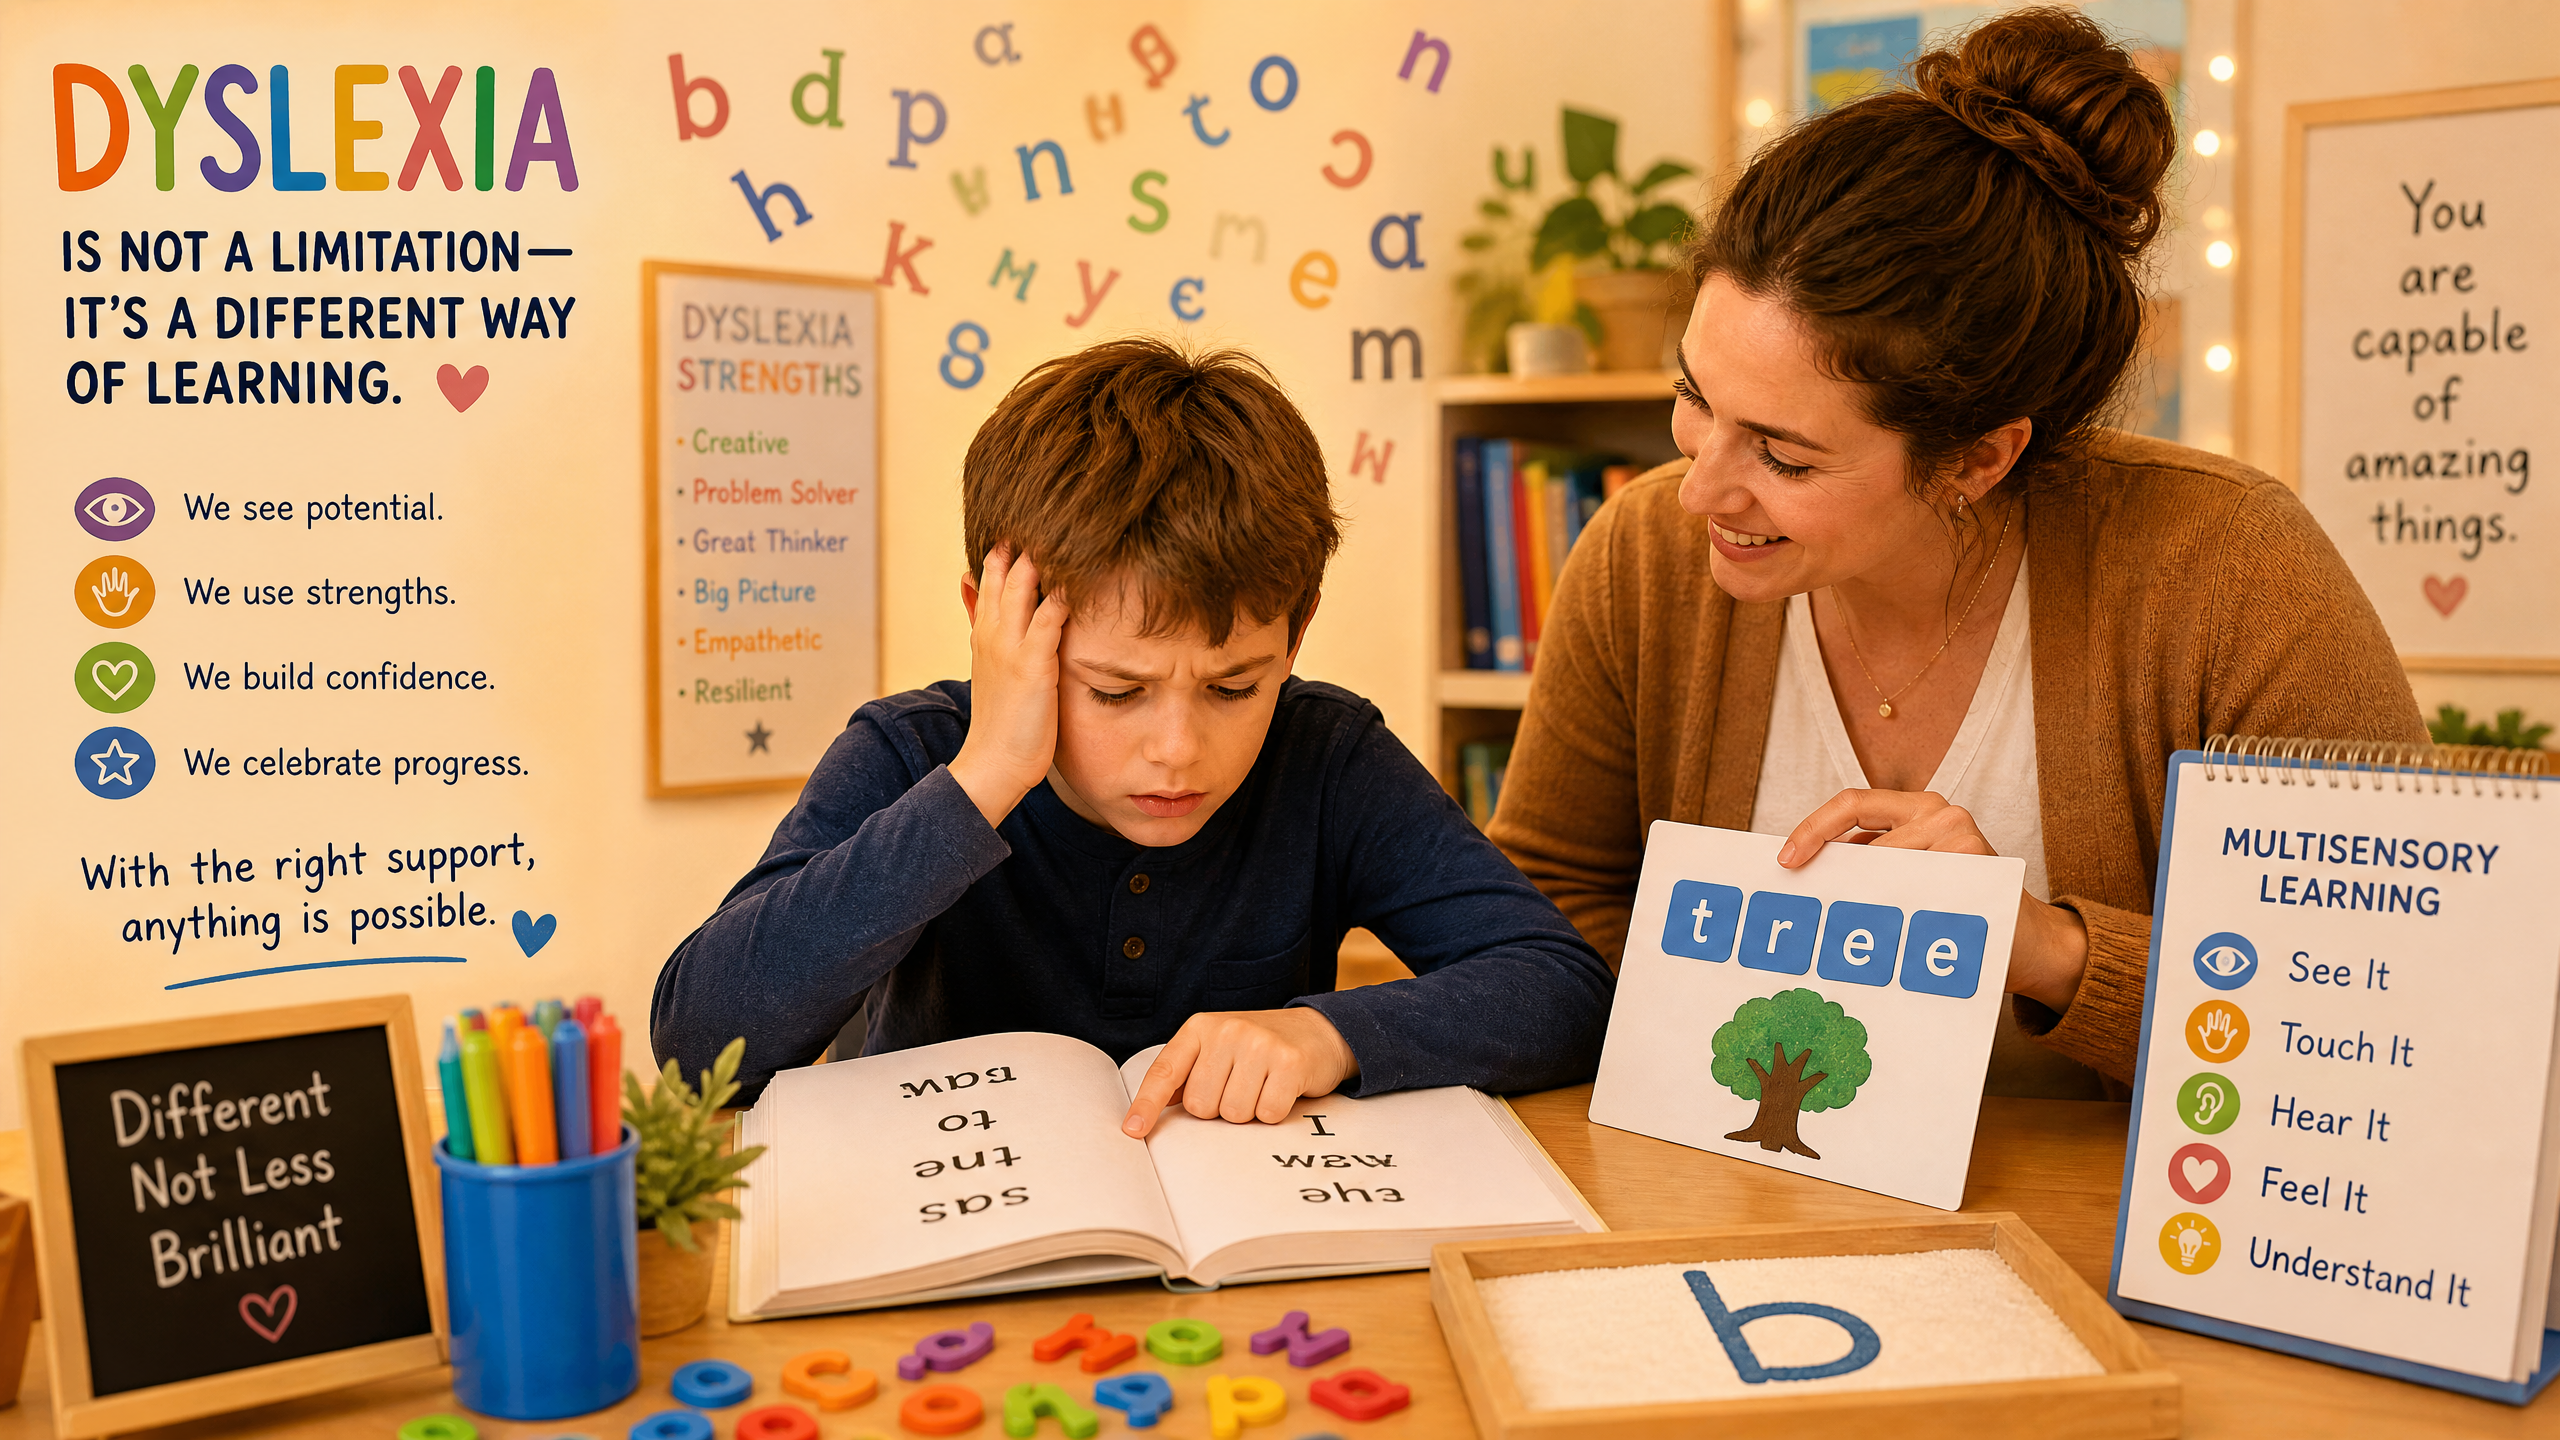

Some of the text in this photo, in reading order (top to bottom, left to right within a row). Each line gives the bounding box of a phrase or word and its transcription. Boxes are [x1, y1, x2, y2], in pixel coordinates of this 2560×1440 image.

[790, 48, 846, 129] d
[1397, 30, 1451, 94] n
[668, 53, 730, 142] b
[887, 89, 948, 170] p
[1015, 139, 1074, 202] n
[730, 169, 813, 243] h
[2401, 181, 2484, 235] You
[1064, 259, 1121, 329] y
[1289, 250, 1339, 310] e
[2401, 265, 2474, 294] are
[683, 303, 853, 347] DYSLEXIA
[2353, 308, 2527, 374] capable
[678, 358, 862, 398] STRENGTHS
[1351, 327, 1424, 381] m
[2414, 375, 2461, 421] of
[693, 428, 788, 455] Creative
[2346, 438, 2529, 494] amazing
[694, 478, 858, 505] Problem Solver
[693, 528, 848, 553] Great Thinker
[2372, 500, 2522, 561] things.
[695, 578, 816, 612] Big Picture
[694, 627, 822, 661] Empathetic
[695, 678, 792, 703] Resilient
[2223, 827, 2498, 875] MULTISENSORY
[2260, 875, 2439, 916] LEARNING
[1691, 897, 1959, 977] tree
[2289, 951, 2389, 990] See It
[2281, 1021, 2413, 1067] Touch It
[111, 1071, 330, 1148] Different
[2271, 1094, 2390, 1141] Hear It
[131, 1148, 334, 1212] Not Less
[2262, 1166, 2367, 1213] Feel It
[149, 1203, 342, 1289] Brilliant
[2250, 1237, 2470, 1307] Understand It
[1683, 1270, 1881, 1384] b
